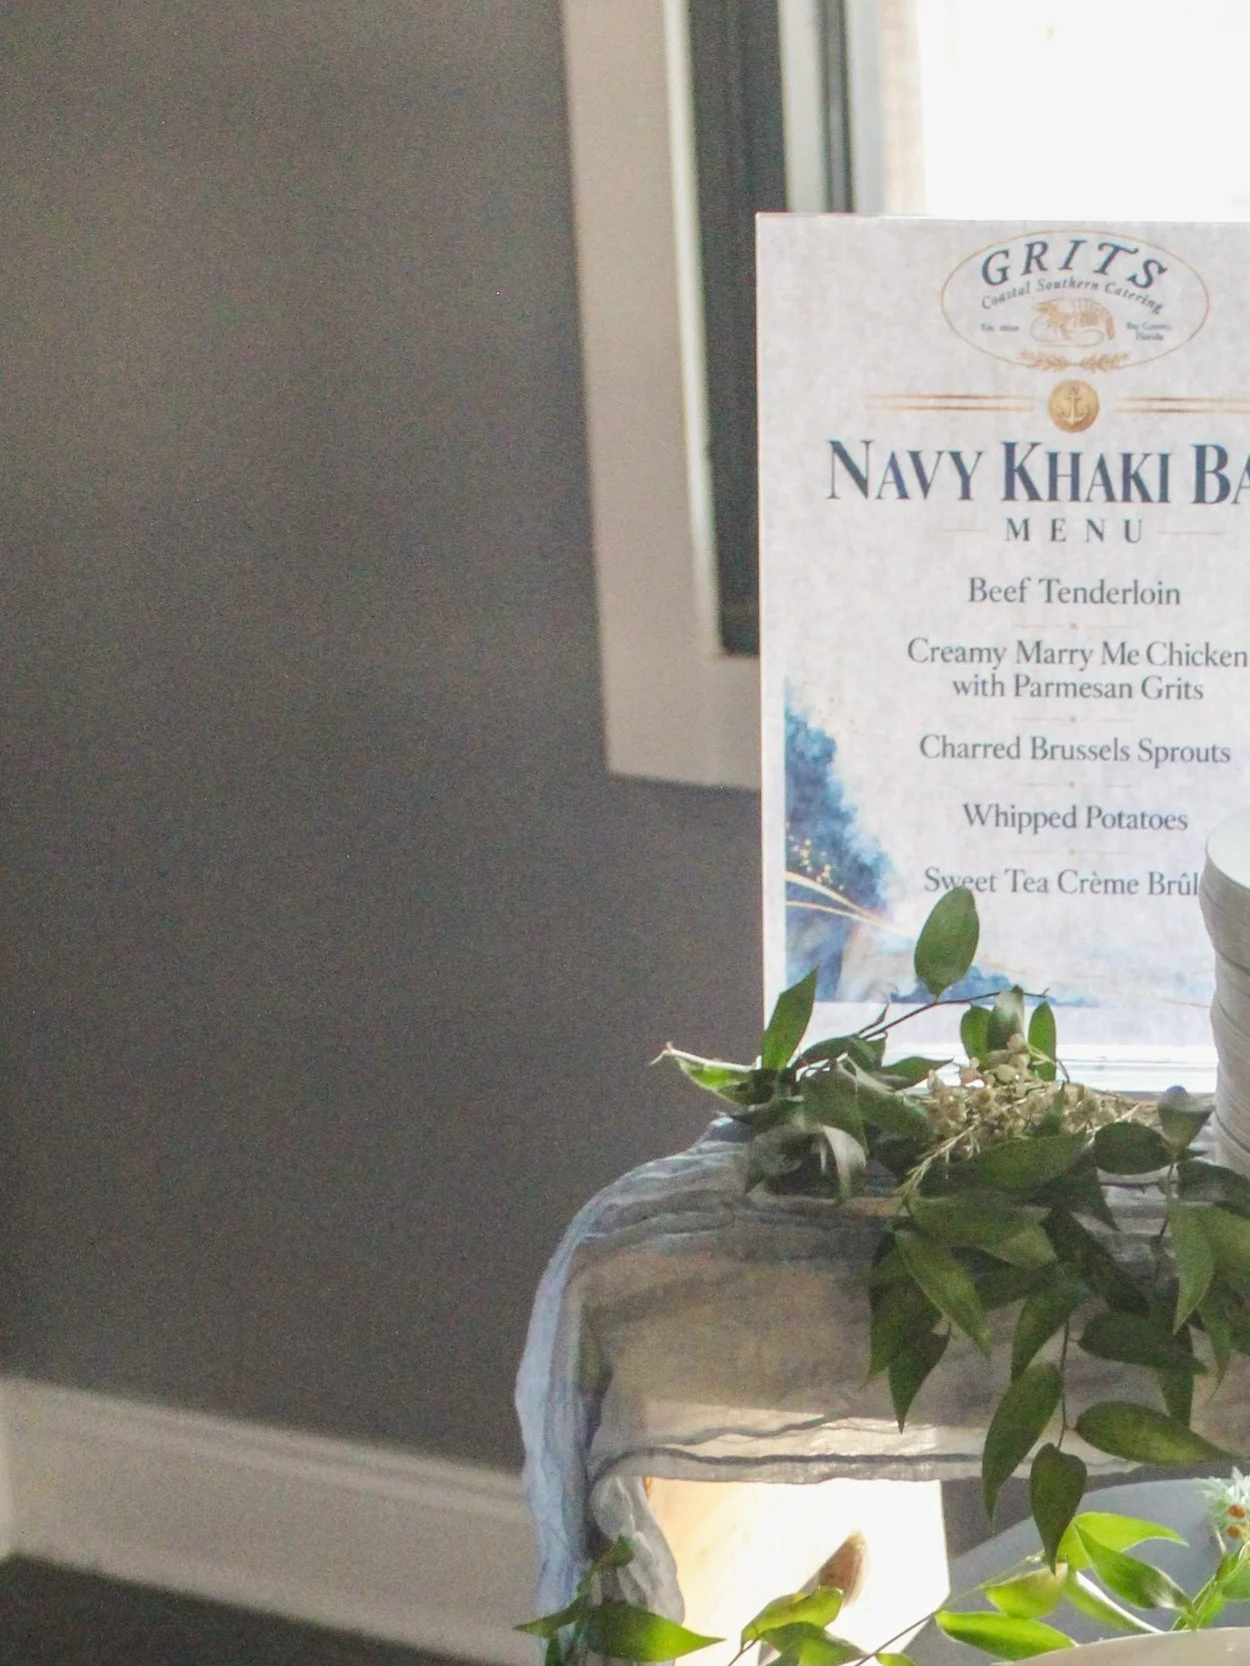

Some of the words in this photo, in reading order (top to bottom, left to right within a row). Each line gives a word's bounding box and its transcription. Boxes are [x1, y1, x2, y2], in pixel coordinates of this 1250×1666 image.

[980, 239, 1168, 290] GRITS
[981, 280, 1031, 310] Coastal
[1035, 275, 1100, 294] Southern
[1104, 280, 1164, 315] Catering
[827, 439, 984, 502] NAVY
[1000, 441, 1172, 504] KHAKI
[1006, 517, 1144, 545] MENU
[968, 576, 1032, 605] Beef
[1037, 577, 1182, 607] Tenderloin
[906, 637, 1008, 670] Creamy
[1015, 639, 1094, 670] Marry
[1101, 640, 1140, 667] Me
[1145, 641, 1249, 669] Chicken
[952, 672, 1005, 699] with
[1013, 673, 1133, 700] Parmesan
[1140, 675, 1205, 702] Grits
[919, 734, 1022, 761] Charred
[1030, 736, 1131, 763] Brussels
[1137, 738, 1232, 768] Sprouts
[962, 802, 1077, 836] Whipped
[1085, 804, 1190, 833] Potatoes
[923, 866, 998, 893] Sweet
[1003, 868, 1050, 894] Tea
[1057, 869, 1140, 896] Crème
[1147, 870, 1199, 896] Brûl
